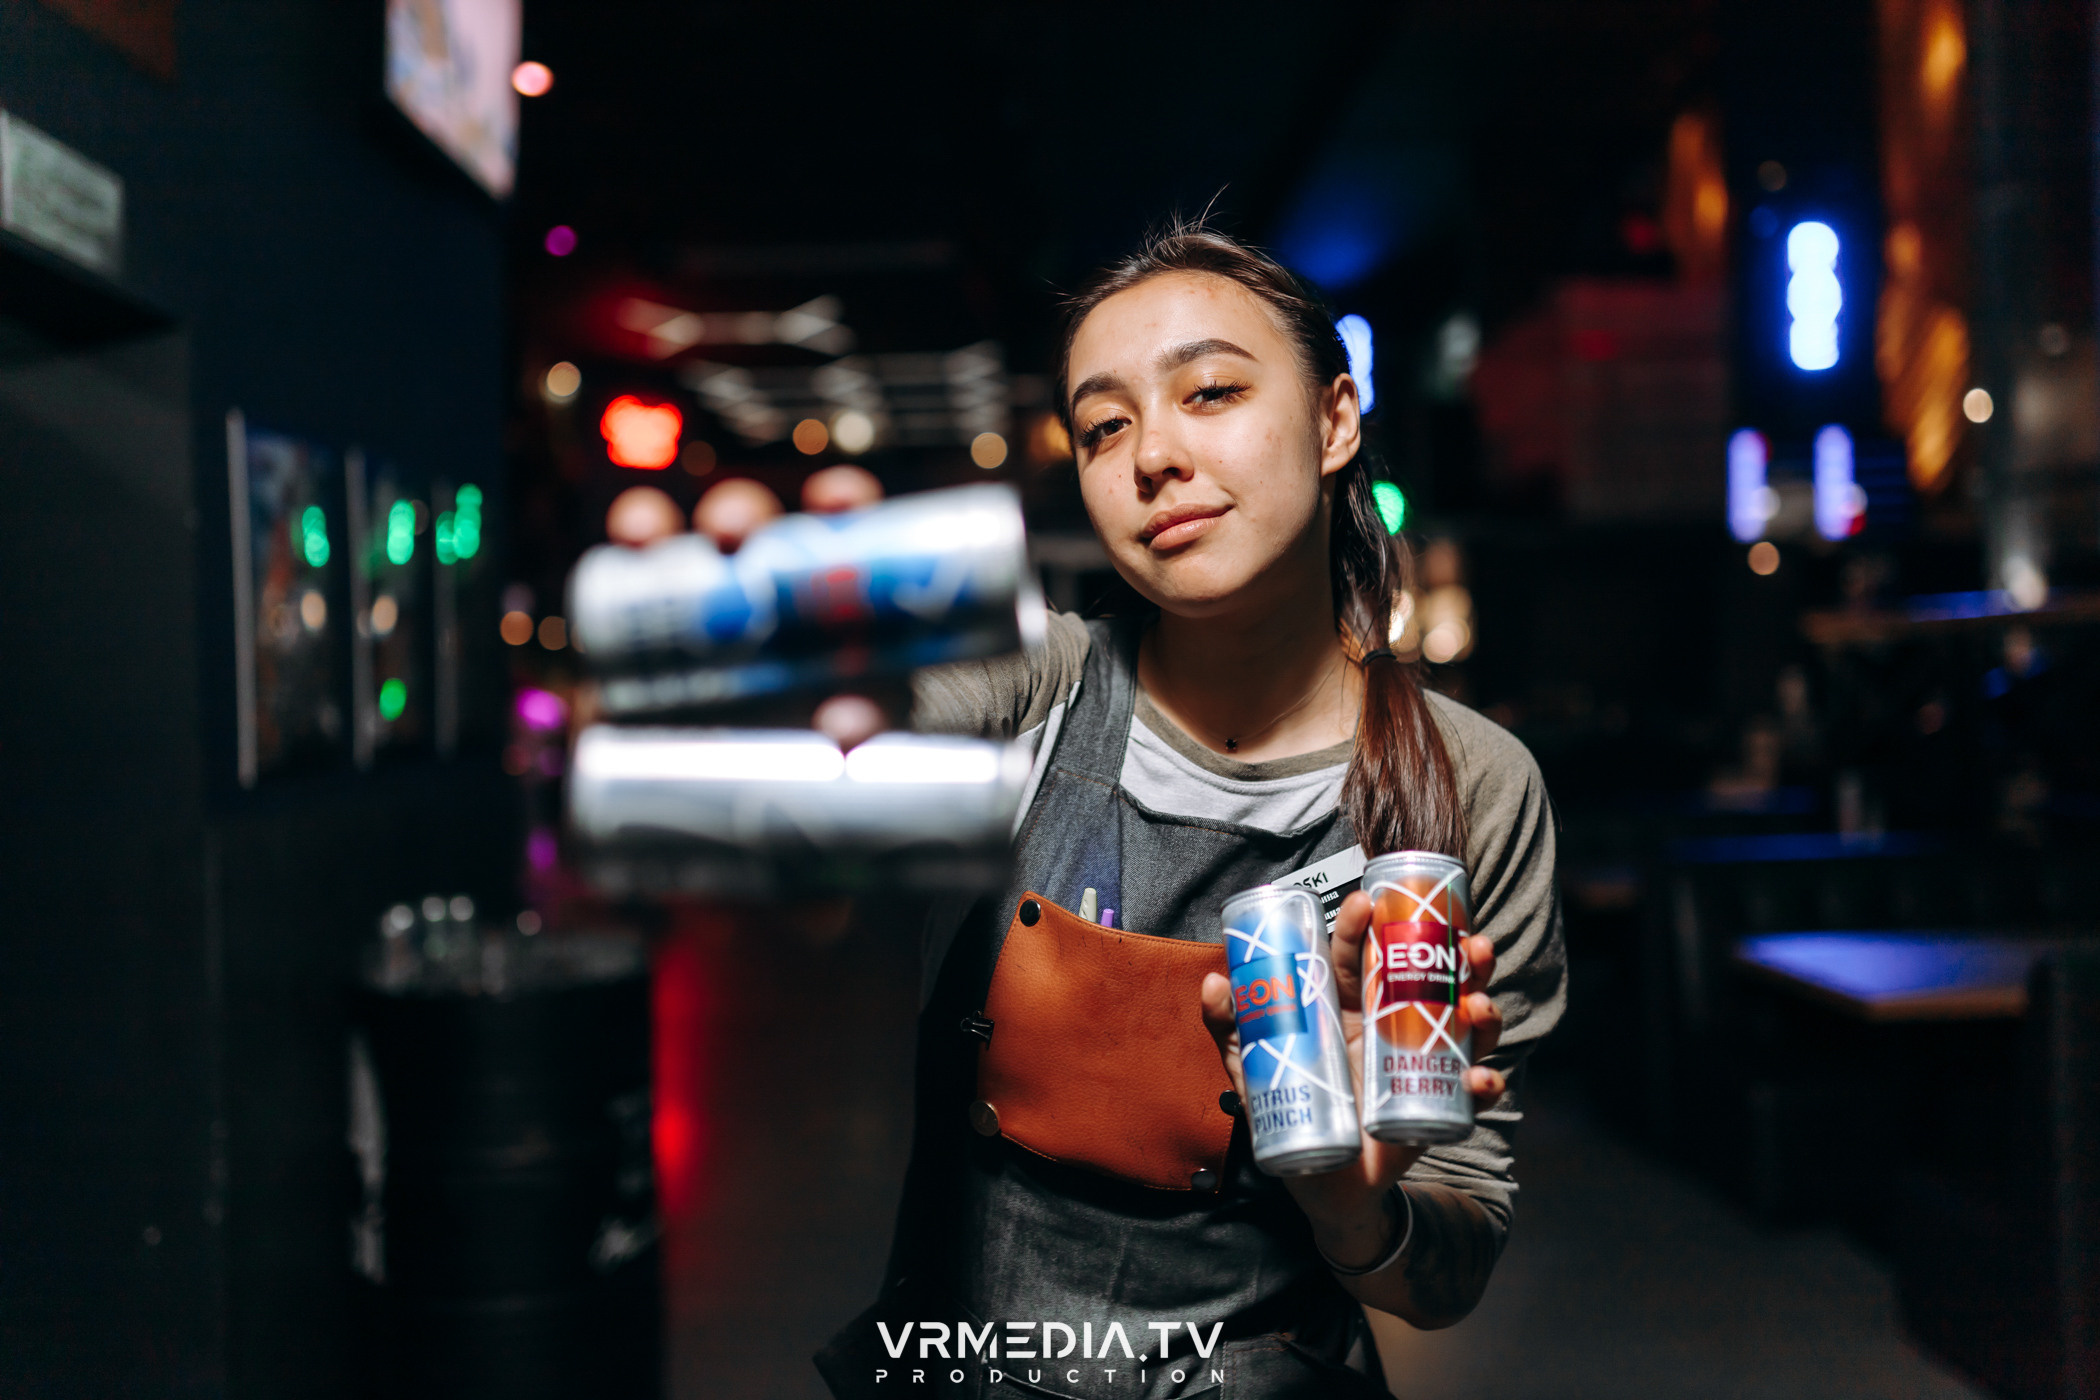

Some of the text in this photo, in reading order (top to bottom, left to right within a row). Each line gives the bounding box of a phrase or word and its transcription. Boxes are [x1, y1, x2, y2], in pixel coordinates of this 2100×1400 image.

[1387, 941, 1456, 972] EON
[1387, 971, 1427, 983] ENERGY
[1235, 973, 1296, 1013] EON
[1383, 1054, 1461, 1076] DANGER
[1251, 1085, 1312, 1114] CITRUS
[1391, 1077, 1456, 1097] BERRY
[1255, 1107, 1313, 1136] PUNCH
